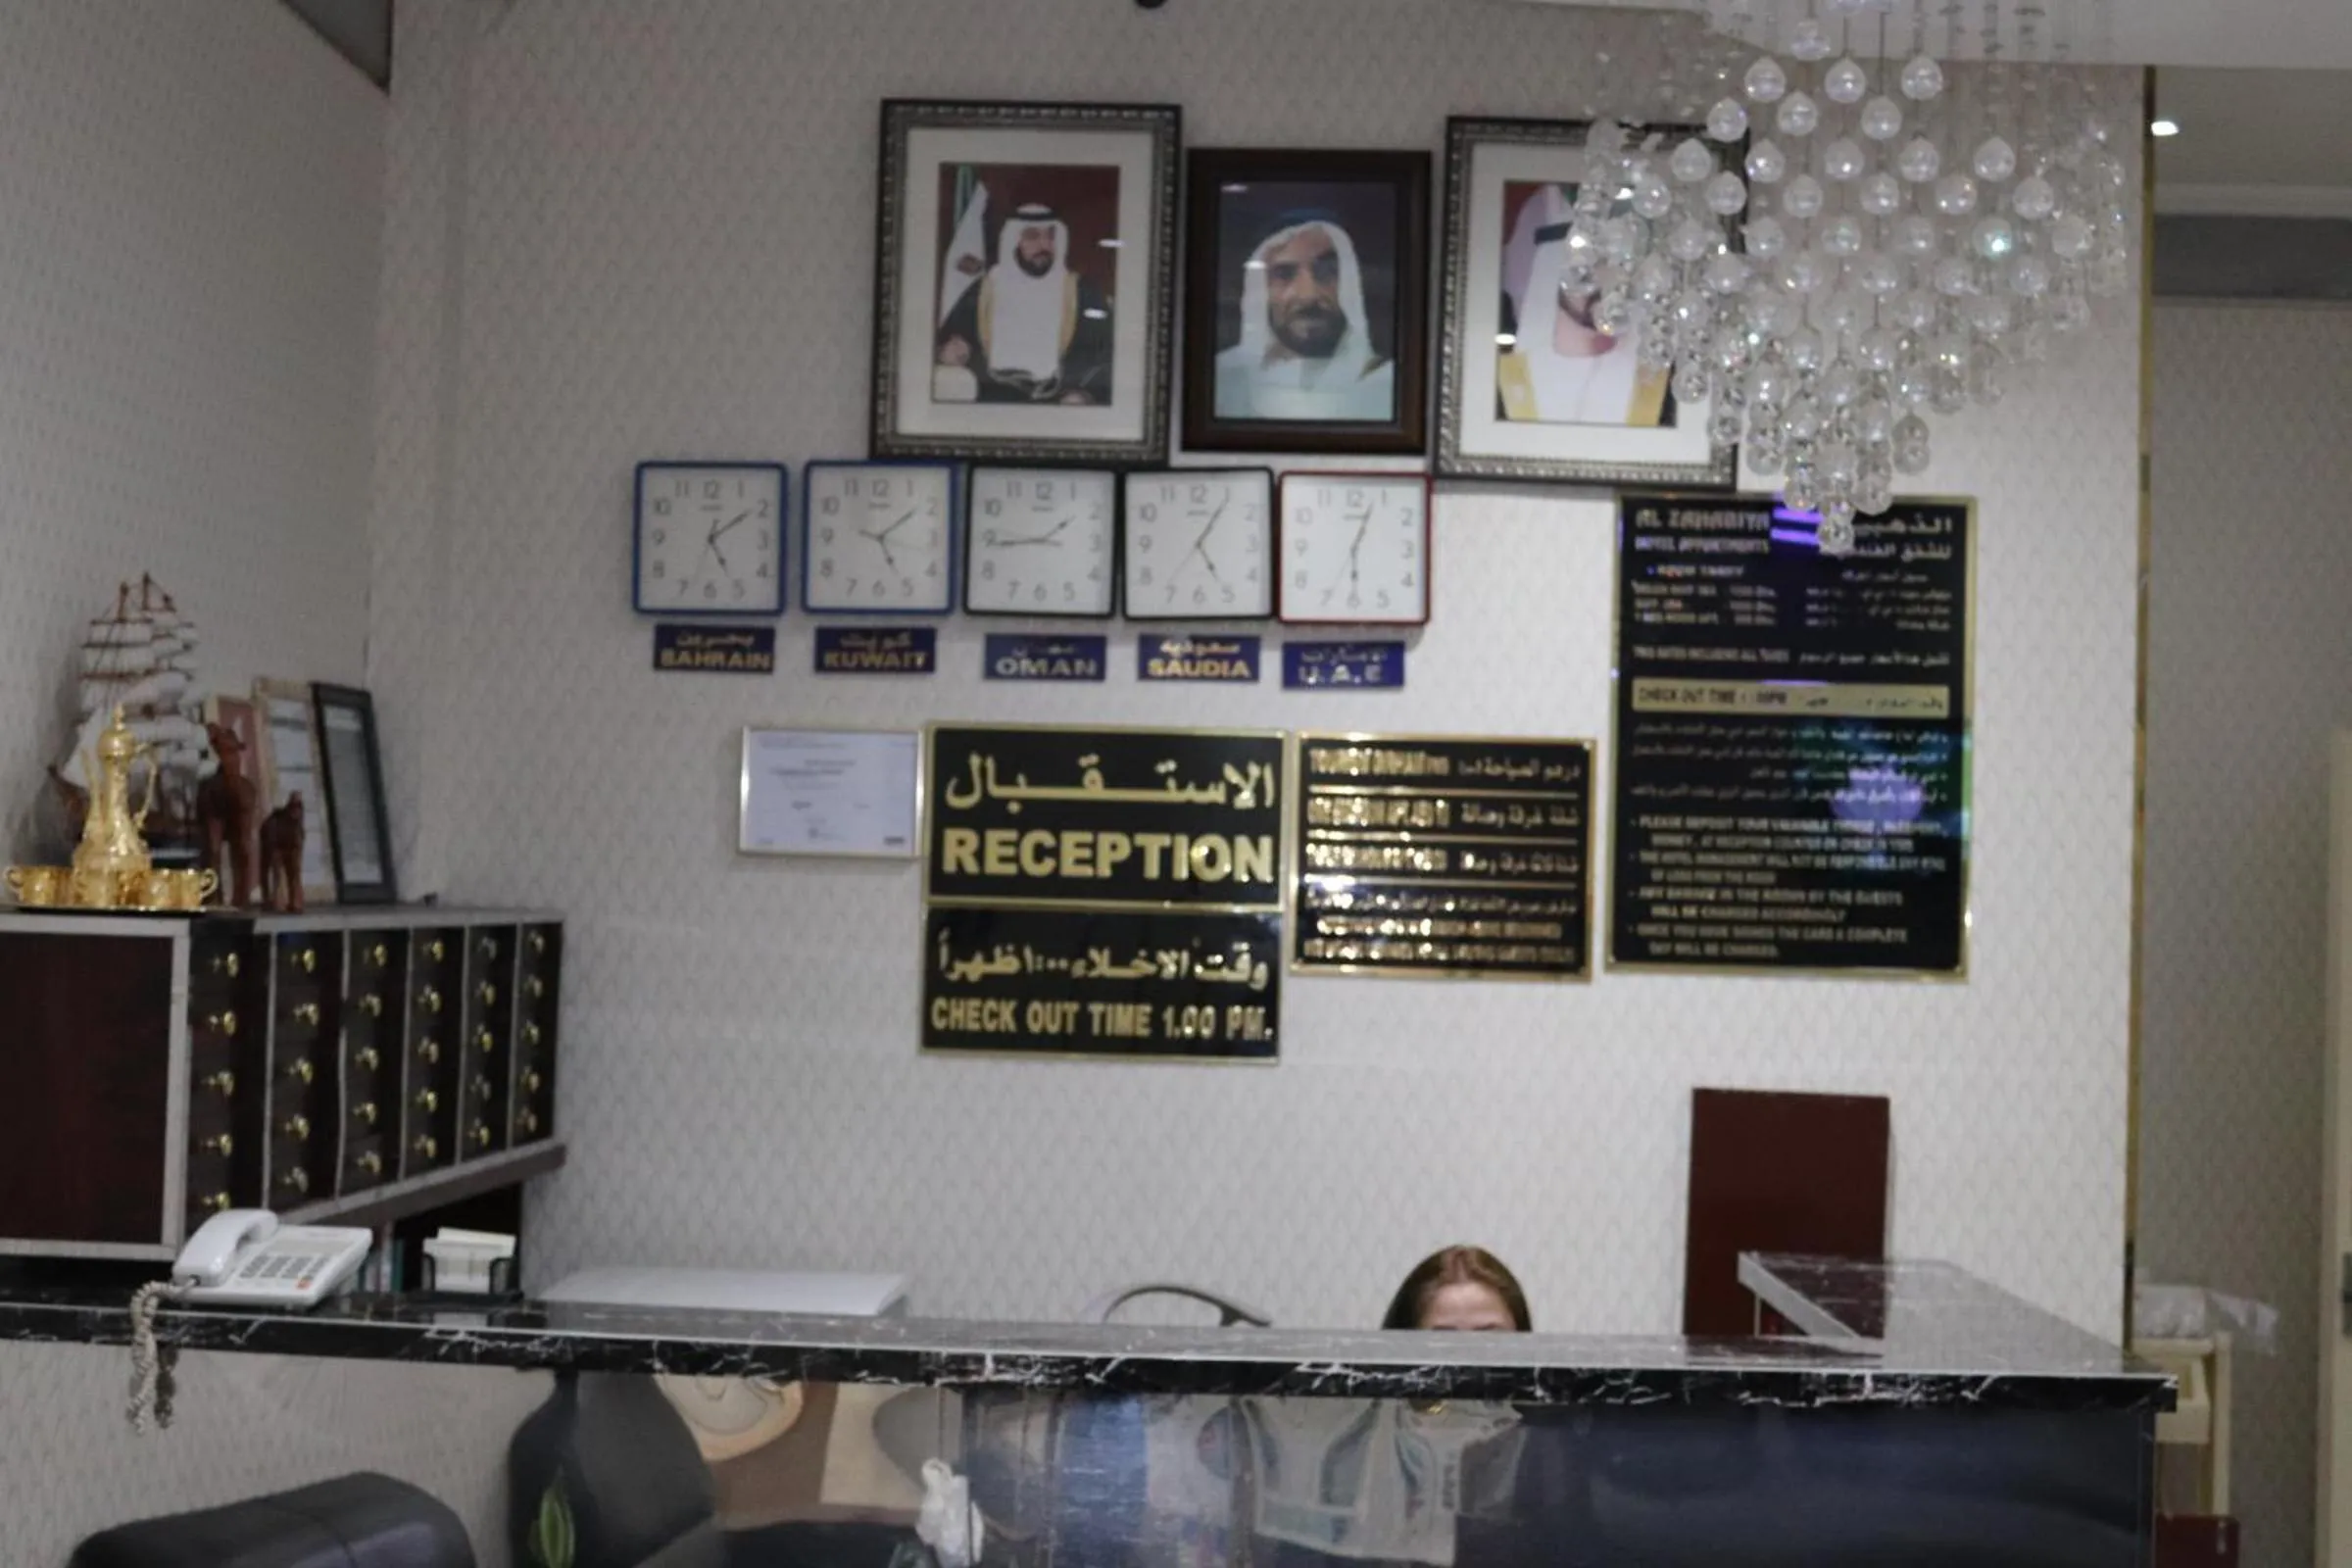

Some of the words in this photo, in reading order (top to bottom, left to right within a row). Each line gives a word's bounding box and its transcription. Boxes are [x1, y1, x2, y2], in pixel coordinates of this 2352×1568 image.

[661, 648, 771, 668] BAHRAIN
[824, 650, 927, 668] KUWAIT
[996, 657, 1097, 676] OMAN
[1148, 658, 1250, 677] SAUDIA
[946, 752, 1275, 814] الاستقبال
[942, 827, 1274, 883] RECEPTION
[1194, 941, 1268, 991] وقت
[931, 997, 1018, 1034] CHECK
[1026, 1000, 1080, 1035] OUT
[1088, 1004, 1152, 1037] TIME
[1162, 1004, 1216, 1039] 1.00
